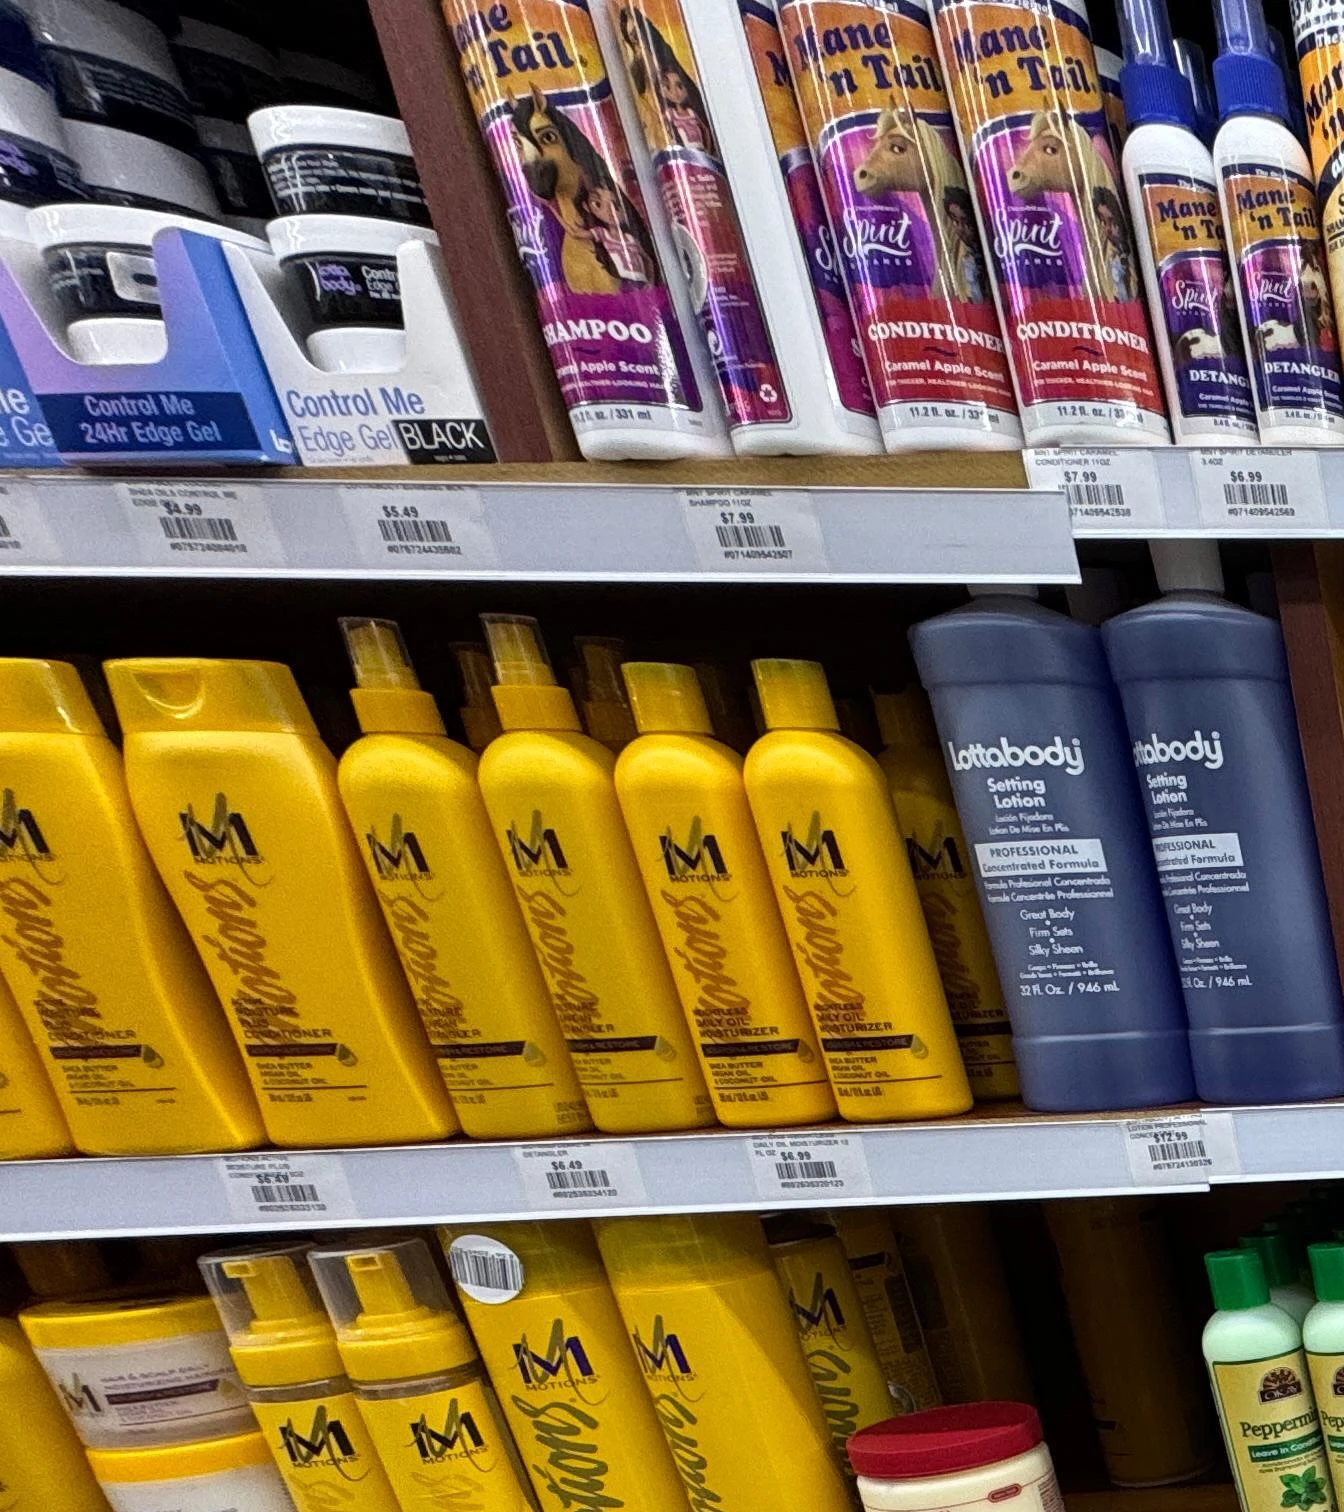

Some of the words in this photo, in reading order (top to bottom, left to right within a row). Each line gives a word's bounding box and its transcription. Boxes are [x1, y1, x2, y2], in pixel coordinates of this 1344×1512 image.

[952, 24, 1051, 66] Mane
[1017, 322, 1148, 353] CONDITIONER
[84, 395, 159, 417] Control
[163, 398, 194, 415] Me
[286, 388, 378, 419] Control
[384, 388, 424, 415] Me
[81, 422, 128, 445] 24Hr
[132, 424, 183, 445] Edge
[187, 422, 223, 442] Gel
[301, 427, 353, 453] Edge
[361, 423, 397, 450] Gel
[400, 423, 483, 450] BLACK
[1064, 471, 1097, 483] $7.99
[1230, 470, 1262, 483] $6.99
[383, 505, 418, 519] $5.49
[720, 512, 755, 524] $7.99
[948, 737, 1084, 776] Lottabody
[988, 777, 1046, 795] Setting
[995, 793, 1045, 808] Lotion
[990, 845, 1078, 857] PROFESSIONAL
[982, 859, 1046, 873] Concentrated
[1049, 858, 1099, 870] Formula
[1020, 909, 1046, 920] Great
[1048, 908, 1074, 921] Body
[1052, 943, 1083, 954] Sheen
[551, 1160, 582, 1170] $6.49
